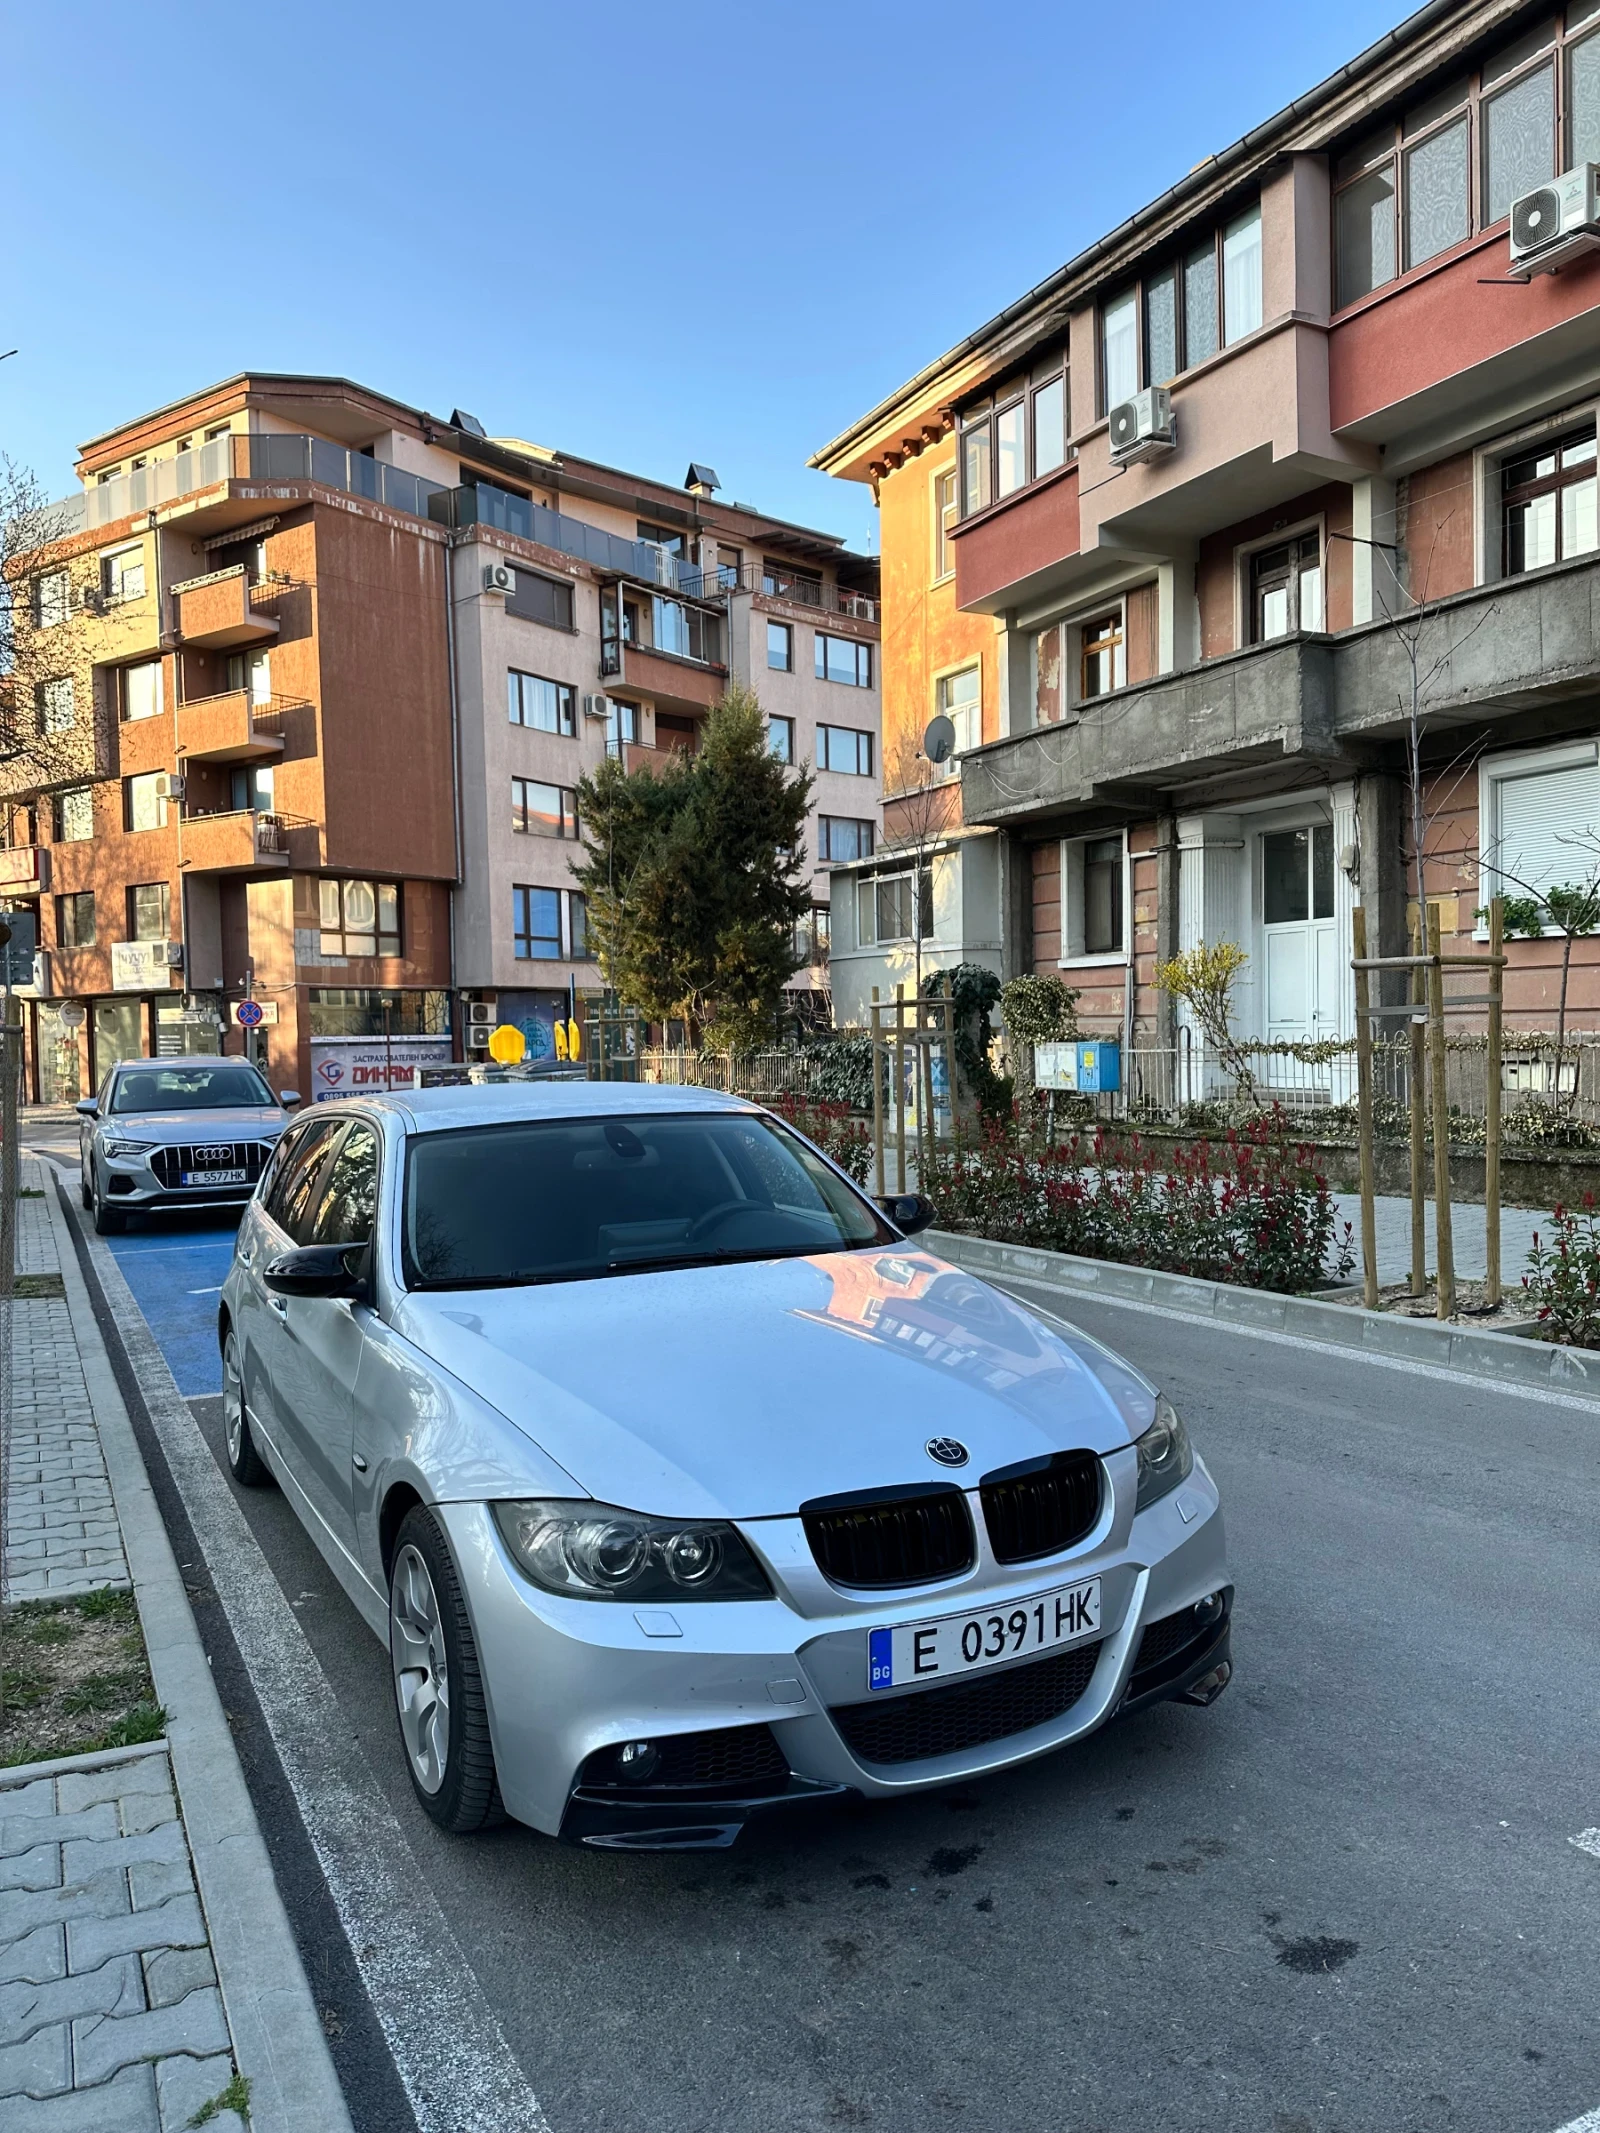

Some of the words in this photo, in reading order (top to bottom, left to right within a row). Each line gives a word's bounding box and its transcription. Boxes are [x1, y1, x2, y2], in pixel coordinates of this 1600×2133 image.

[353, 1054, 419, 1063] ЗАСТРАХОВАТЕЛЕН
[421, 1053, 446, 1061] БРОКЕР
[352, 1065, 414, 1085] ДИНАМ
[192, 1173, 199, 1183] E
[914, 1627, 939, 1674] E
[873, 1665, 890, 1681] BG
